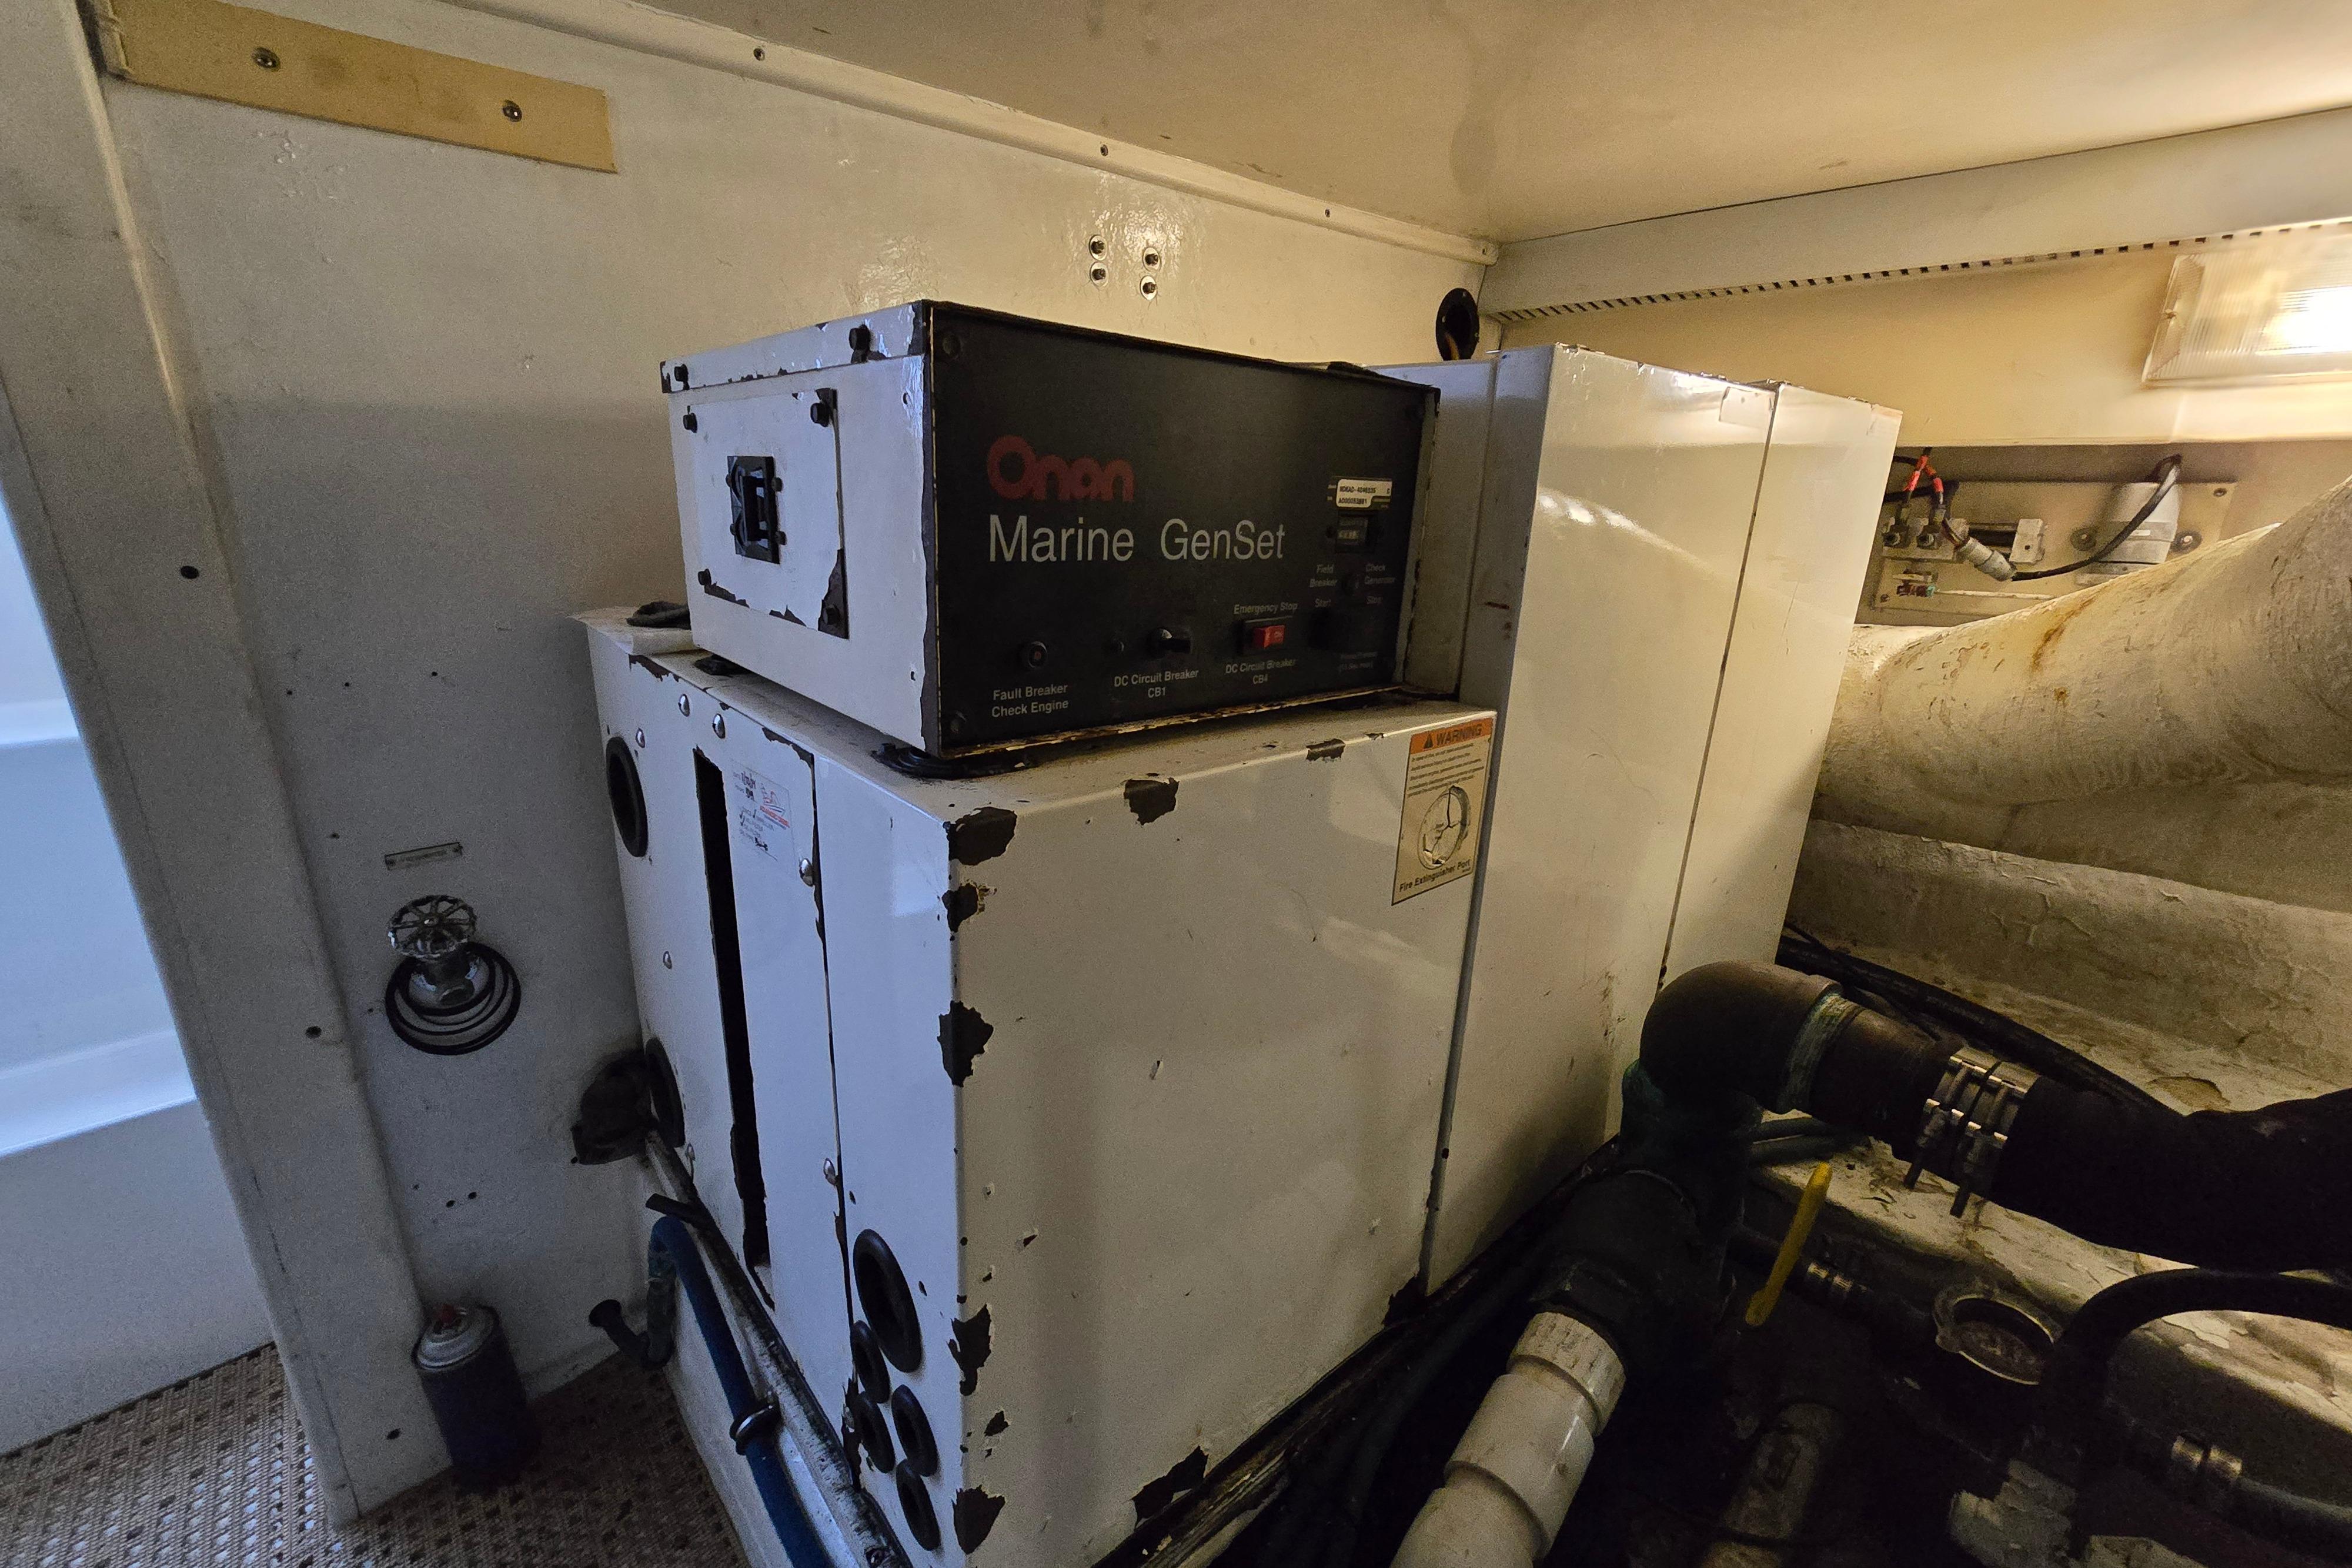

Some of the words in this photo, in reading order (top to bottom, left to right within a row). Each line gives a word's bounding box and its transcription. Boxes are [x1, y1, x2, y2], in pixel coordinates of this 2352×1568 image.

[987, 435, 1135, 502] Onan
[990, 514, 1134, 562] Marine
[1161, 518, 1285, 560] GenSet
[1316, 564, 1335, 574] Field
[1309, 577, 1338, 588] Breaker
[1234, 604, 1278, 615] Emergency
[1280, 601, 1298, 613] Stop
[1315, 598, 1331, 608] Start
[1225, 664, 1238, 674] DC
[1240, 661, 1265, 672] Circuit
[1267, 658, 1296, 670] Breaker
[1114, 675, 1128, 687] DC
[1131, 673, 1162, 685] Circuit
[1164, 669, 1199, 681] Breaker
[1252, 674, 1268, 685] CB4
[993, 688, 1022, 701] Fault
[1025, 684, 1068, 697] Breaker
[1148, 687, 1167, 698] CB1
[991, 704, 1028, 718] Check
[1031, 700, 1069, 714] Engine
[1436, 723, 1482, 746] WARNING
[1399, 881, 1413, 892] Fire
[1414, 865, 1456, 887] Extinguisher
[1456, 859, 1471, 871] Port
